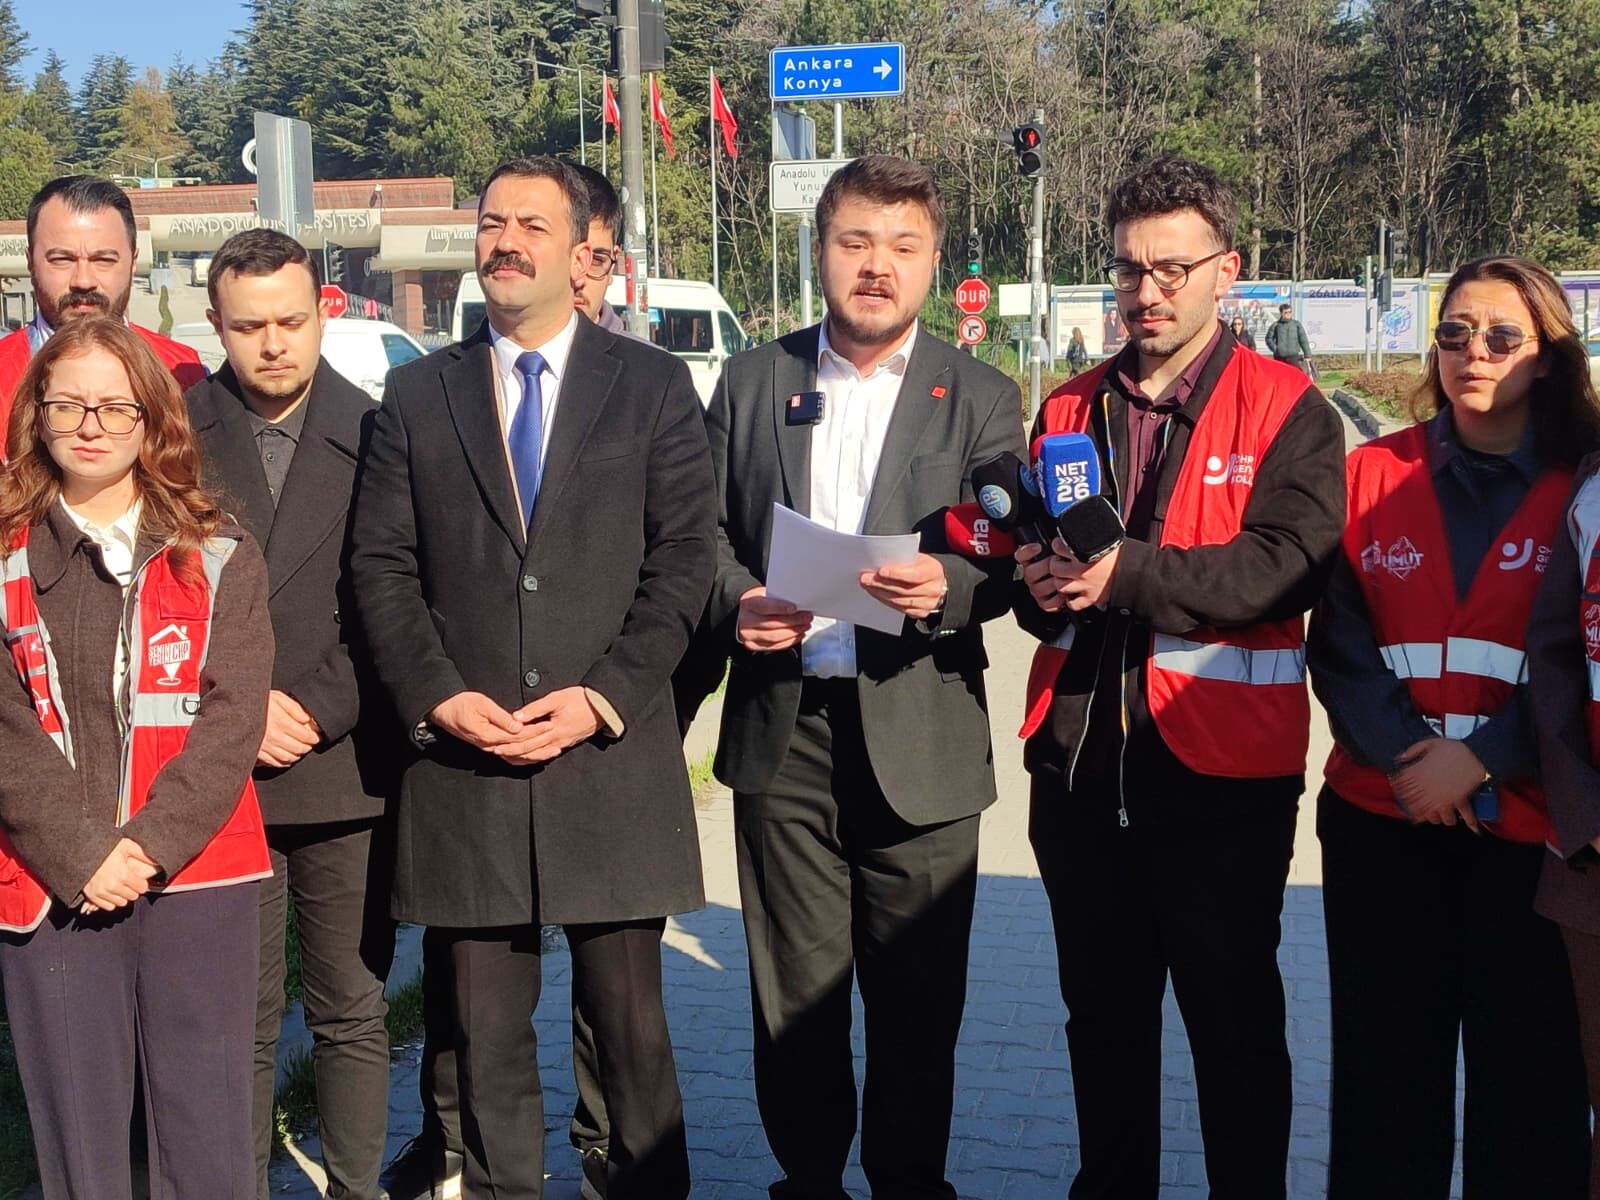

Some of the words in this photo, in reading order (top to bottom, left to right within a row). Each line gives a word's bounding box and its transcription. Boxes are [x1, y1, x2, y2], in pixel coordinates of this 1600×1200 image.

[783, 56, 853, 72] Ankara
[783, 77, 843, 92] Konya
[780, 168, 816, 178] Anadolu
[170, 215, 253, 233] ANADOLU
[959, 289, 987, 304] DUR
[1055, 460, 1089, 477] NET
[1056, 482, 1091, 503] 26
[968, 518, 990, 556] eha
